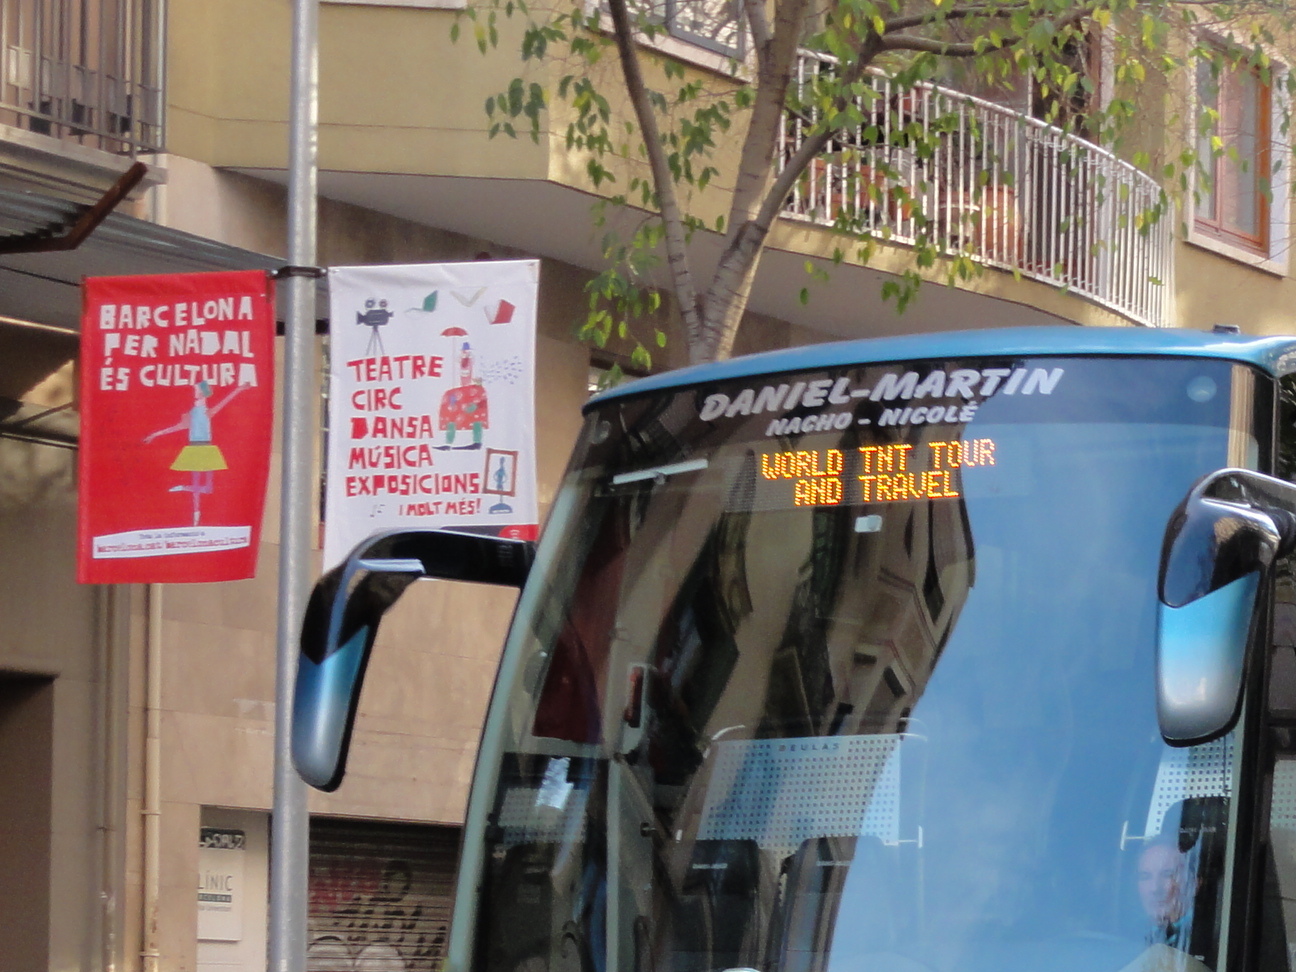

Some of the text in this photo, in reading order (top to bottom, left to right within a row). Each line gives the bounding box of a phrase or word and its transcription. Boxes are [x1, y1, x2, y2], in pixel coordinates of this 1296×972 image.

[99, 296, 253, 330] BARCELONA
[104, 329, 254, 358] PER NADAL
[100, 357, 258, 391] ÉS CULTURA
[346, 355, 444, 382] TEATRE
[352, 387, 403, 412] CIRC
[699, 367, 1065, 421] DANIEL-MARTIN
[351, 415, 434, 439] DANSA
[765, 412, 852, 437] NACHO
[878, 401, 979, 426] NICOLÉ
[348, 444, 434, 470] MÚSICA
[761, 448, 843, 480] WORLD
[928, 438, 996, 469] TOUR
[345, 473, 480, 497] EXPOSICIONS
[794, 470, 959, 507] AND TRAVEL
[406, 502, 441, 516] MOLT
[444, 498, 483, 515] MÉS!
